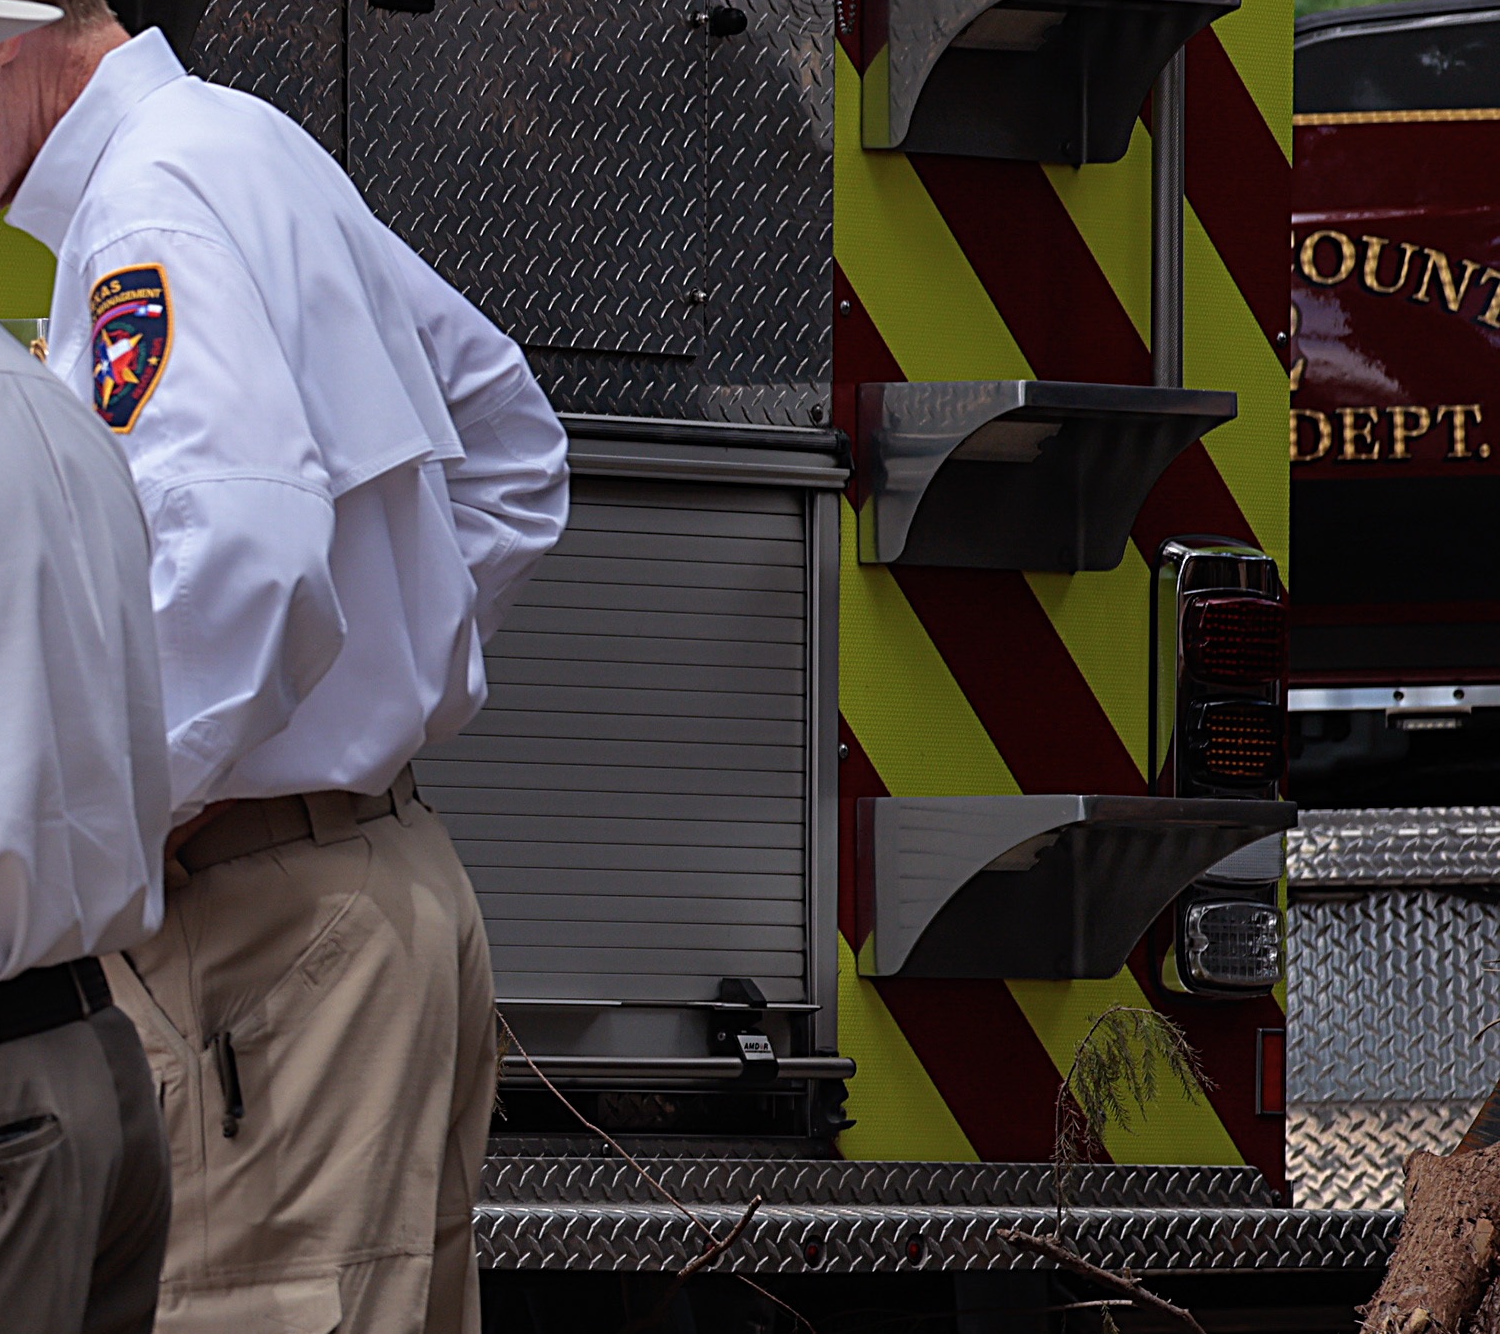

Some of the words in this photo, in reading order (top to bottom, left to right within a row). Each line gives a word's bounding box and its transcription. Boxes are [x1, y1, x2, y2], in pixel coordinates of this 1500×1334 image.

[91, 280, 122, 311] XAS
[1291, 230, 1500, 329] OUNT
[1290, 404, 1491, 461] DEPT.
